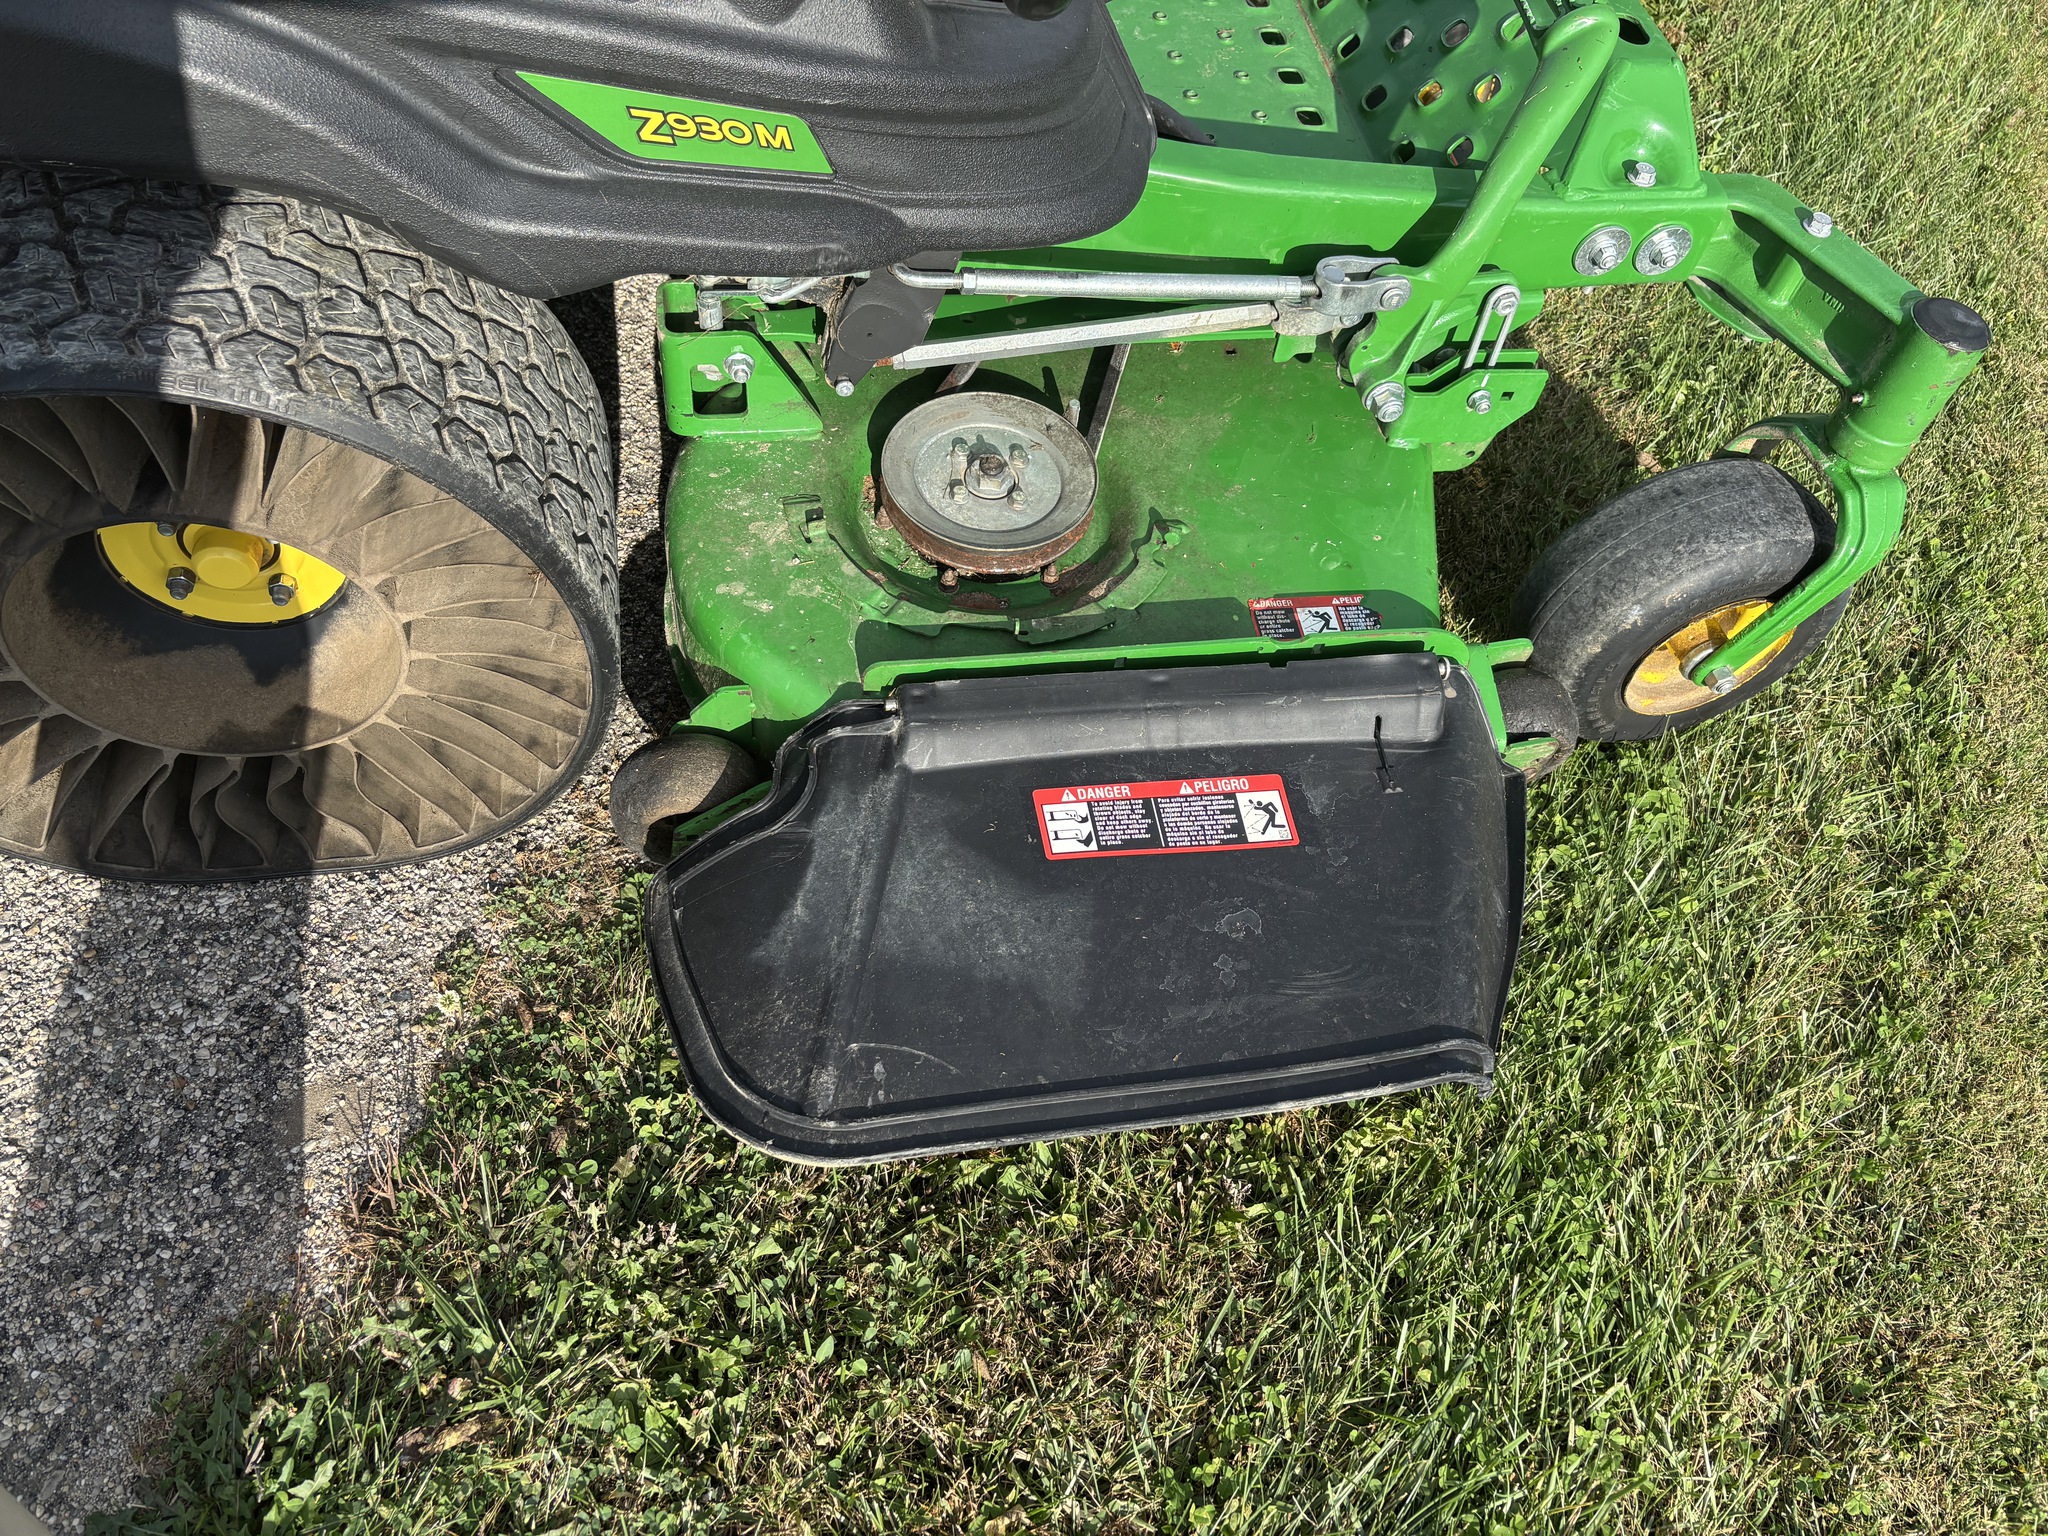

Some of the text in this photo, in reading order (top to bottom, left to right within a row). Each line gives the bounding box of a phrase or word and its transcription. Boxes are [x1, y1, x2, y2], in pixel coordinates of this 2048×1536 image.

[626, 106, 795, 151] Z930M
[1260, 600, 1294, 608] DANGER
[1077, 785, 1131, 800] DANGER
[1194, 778, 1249, 793] PELIGRO
